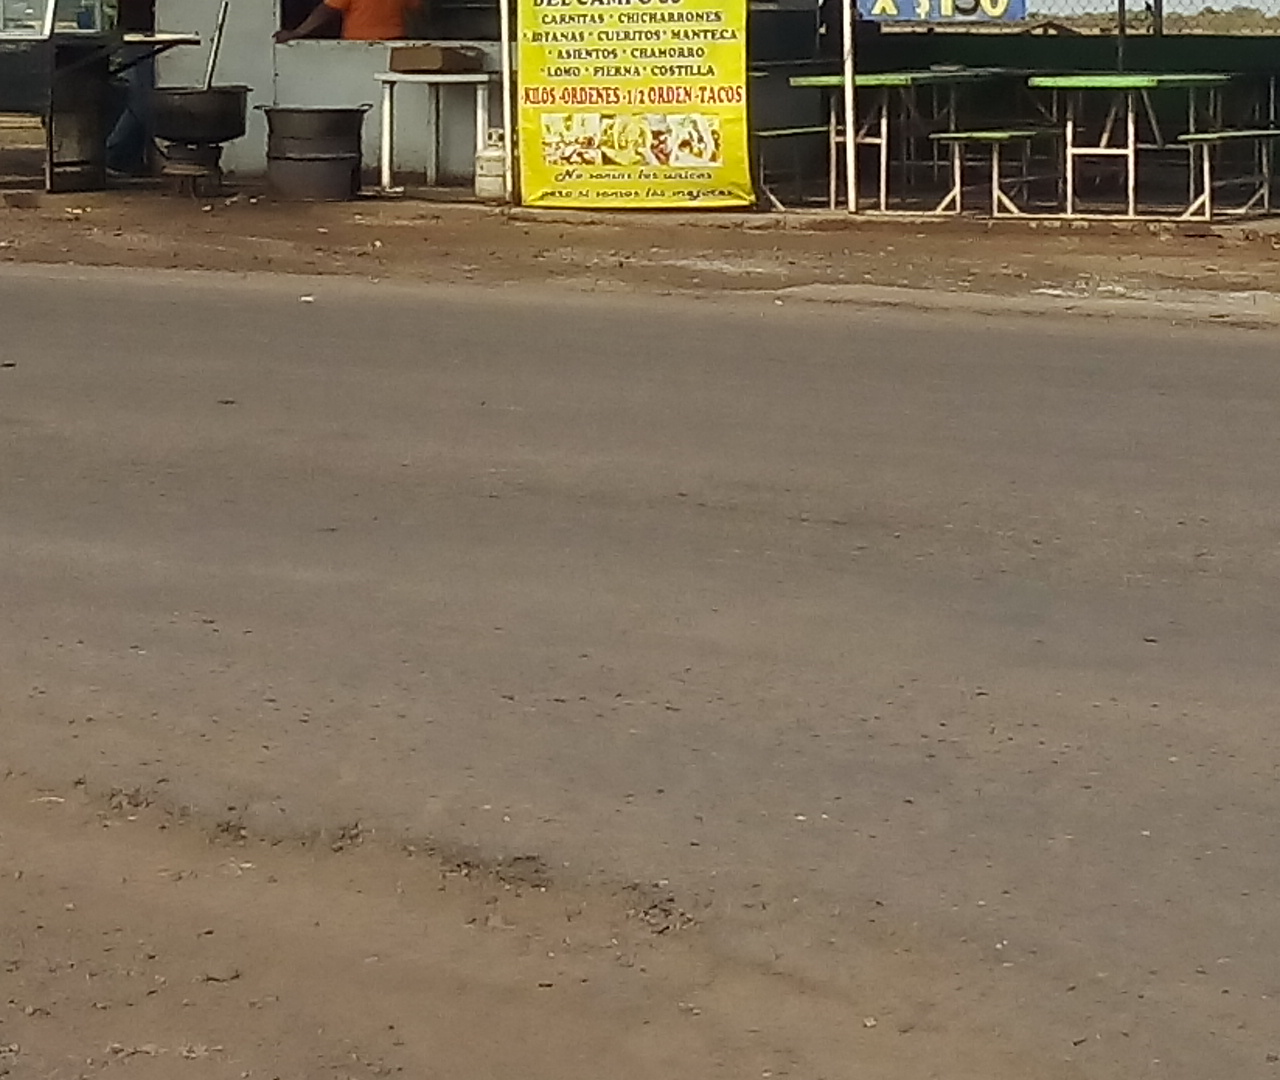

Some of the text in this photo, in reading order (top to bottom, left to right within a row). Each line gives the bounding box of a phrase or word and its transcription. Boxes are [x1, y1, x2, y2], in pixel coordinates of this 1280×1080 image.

[542, 11, 722, 25] CARNITAS CHICHARRONES
[597, 30, 660, 41] CUERITOS
[671, 29, 737, 40] MANTECA
[557, 47, 705, 59] ASIENTOS CHAMORRO
[547, 65, 715, 77] LOMO PIERNA COSTILLA
[648, 87, 692, 104] ORDEN
[554, 169, 583, 182] No
